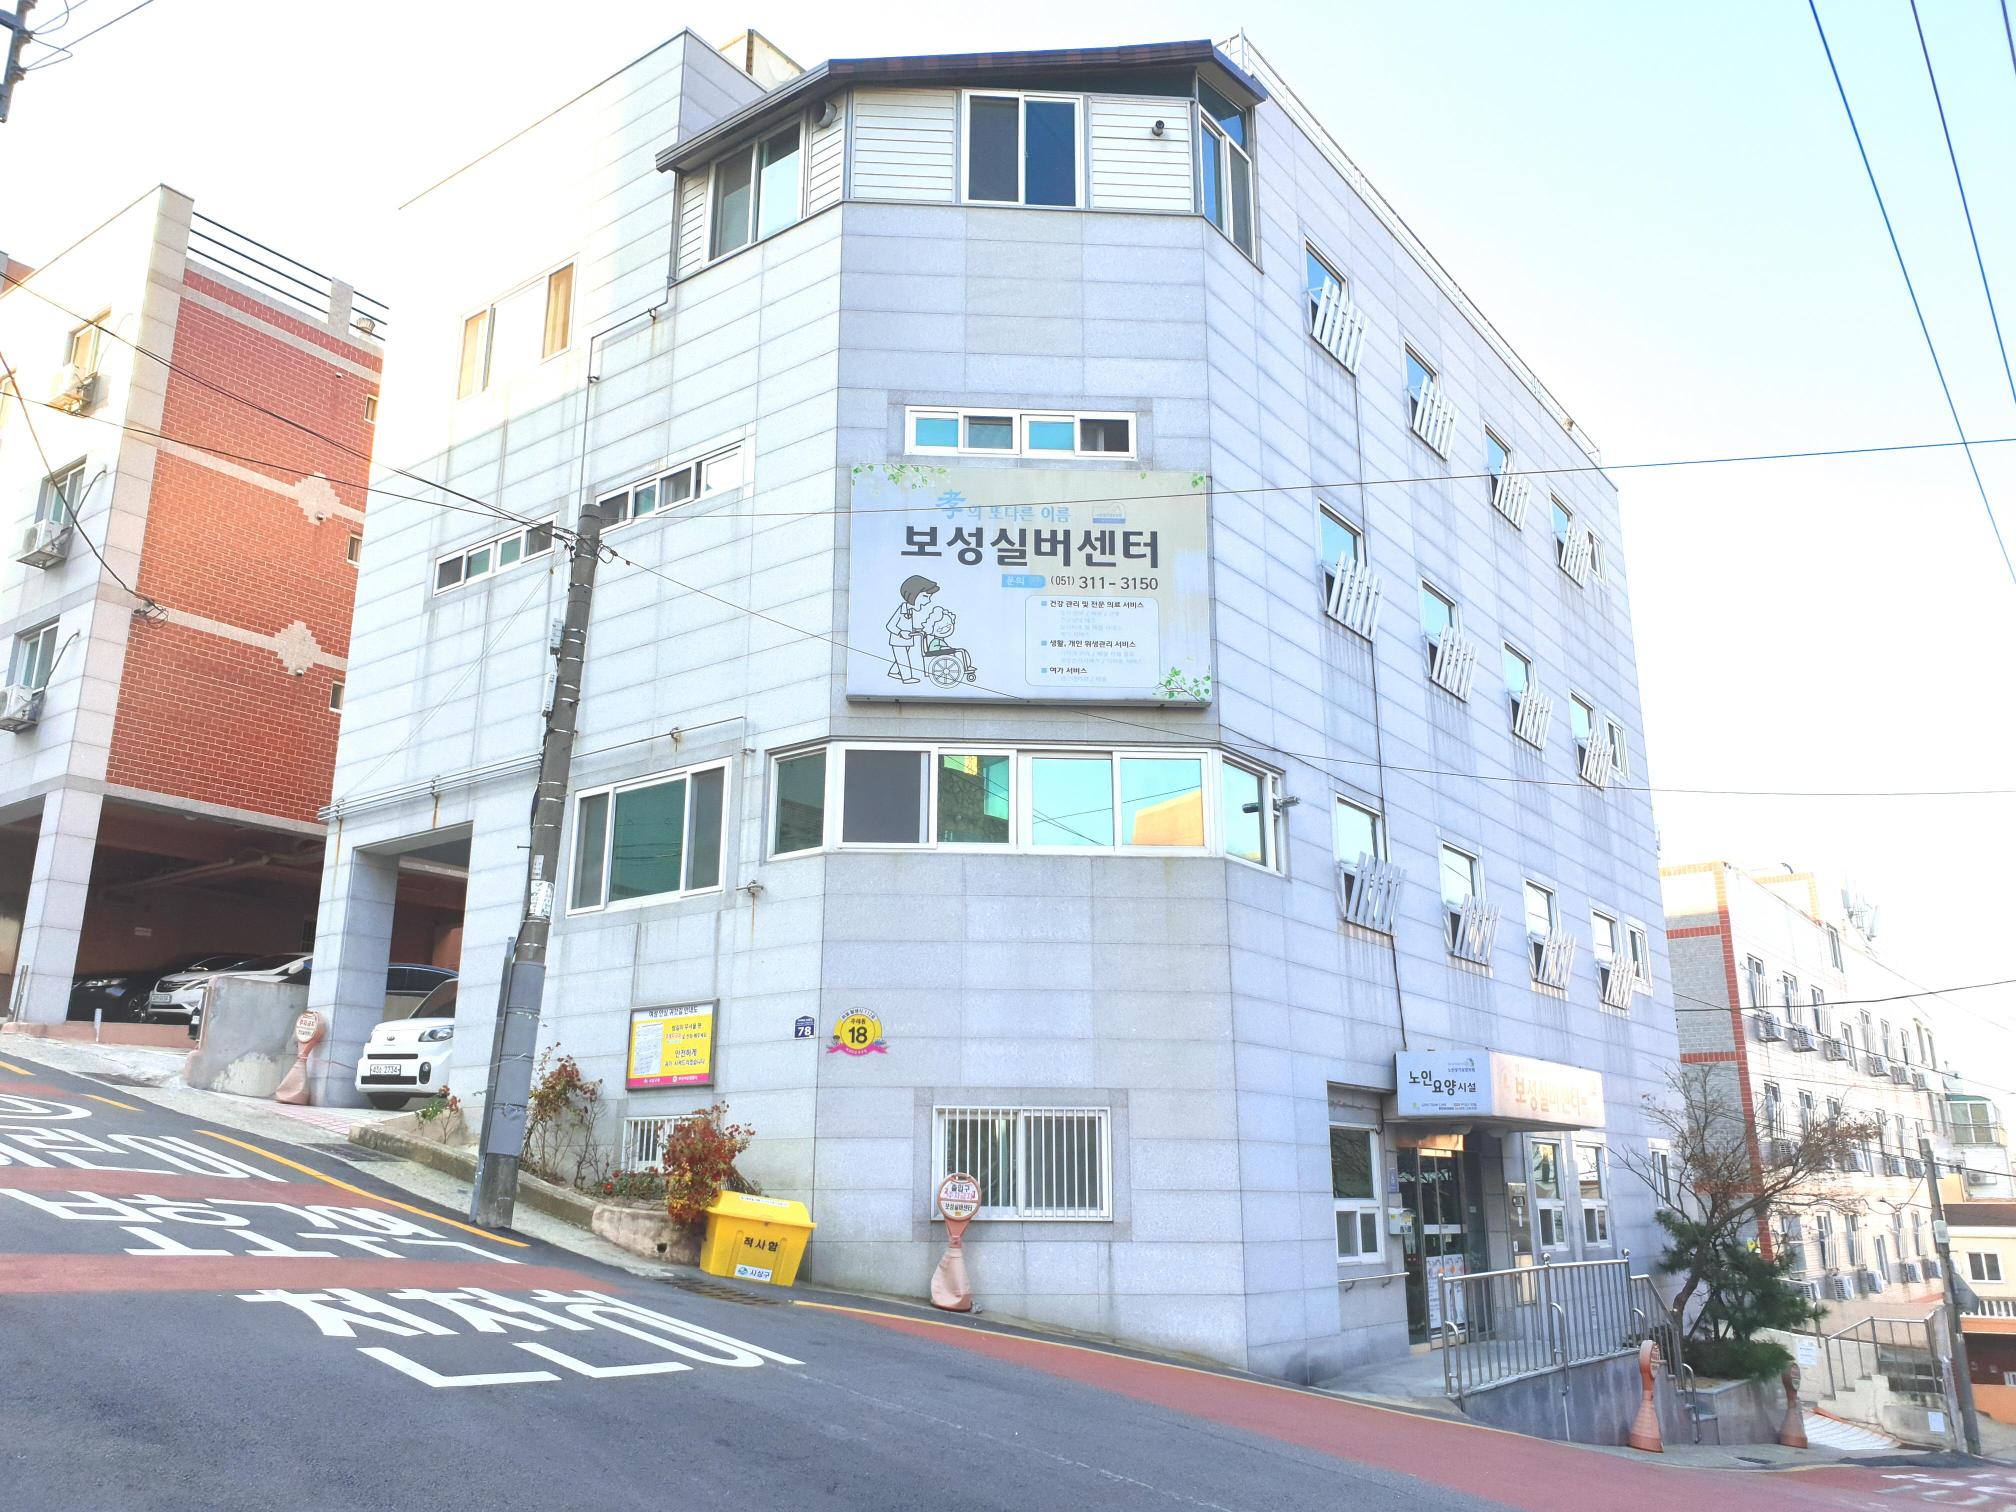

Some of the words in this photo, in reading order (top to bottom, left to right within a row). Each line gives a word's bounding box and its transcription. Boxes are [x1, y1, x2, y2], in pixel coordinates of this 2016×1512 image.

[1040, 505, 1072, 524] 이름
[900, 524, 1159, 570] 보성실버센터
[1050, 575, 1076, 587] (051)
[1049, 600, 1064, 608] 건강
[1065, 600, 1080, 608] 관리
[1081, 600, 1089, 608] 및
[1090, 600, 1105, 609] 전문
[1106, 601, 1121, 609] 의료
[1068, 640, 1083, 648] 개인
[1049, 667, 1064, 675] 여가
[1065, 667, 1088, 675] 서비스
[797, 1026, 812, 1036] 78
[848, 1026, 868, 1044] 18
[743, 1236, 779, 1252] 적사함
[235, 1287, 806, 1388] 천천히
